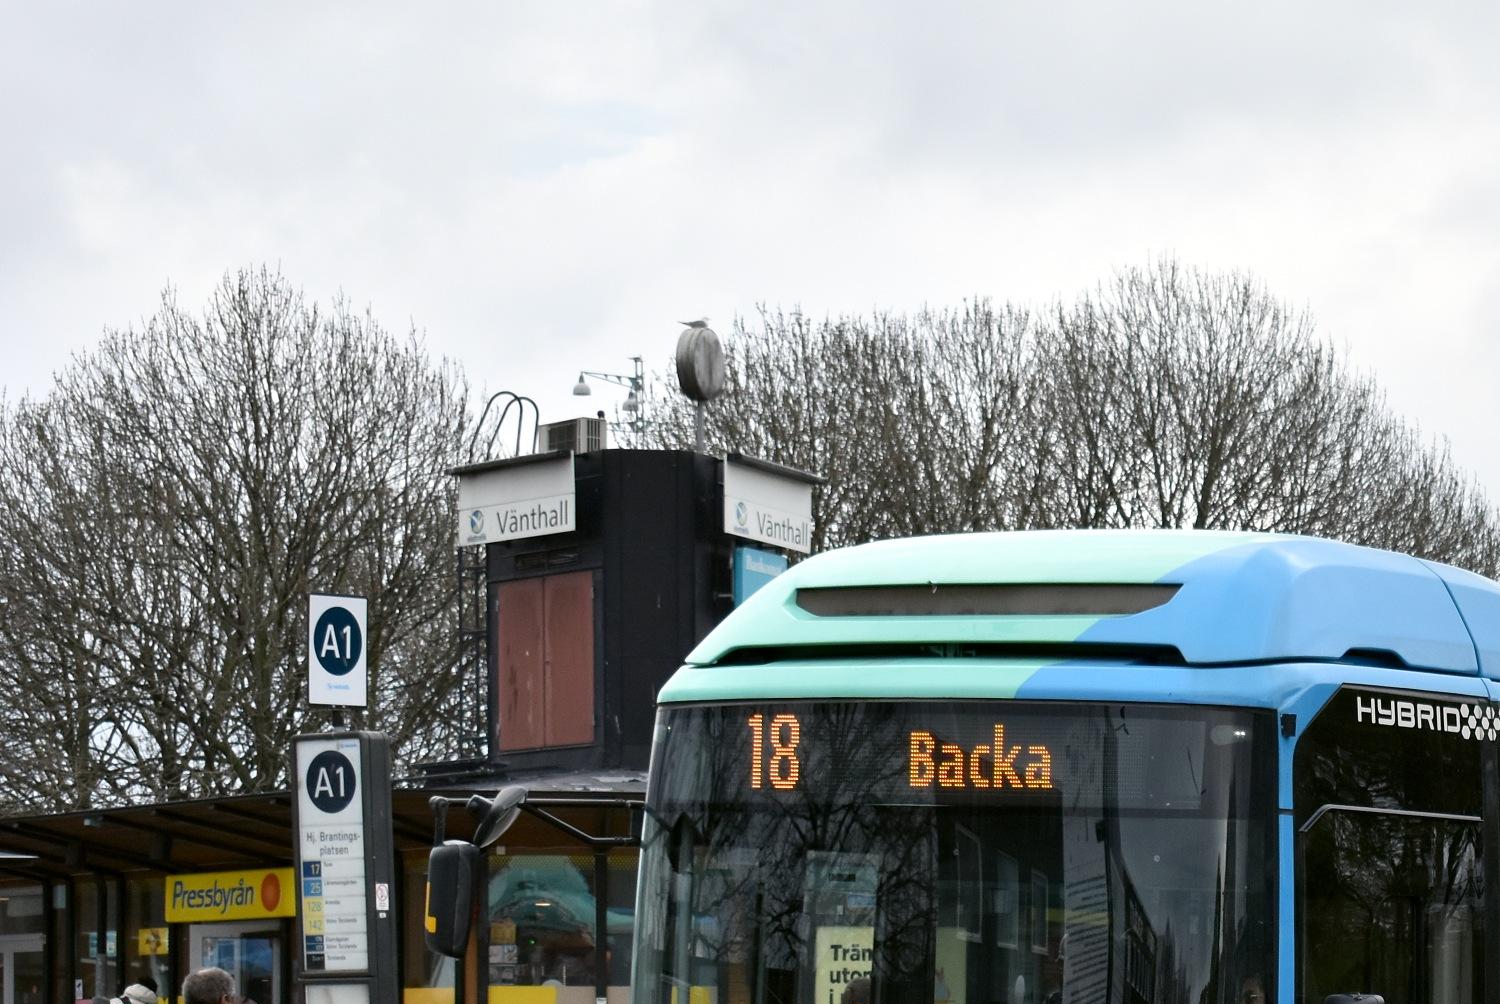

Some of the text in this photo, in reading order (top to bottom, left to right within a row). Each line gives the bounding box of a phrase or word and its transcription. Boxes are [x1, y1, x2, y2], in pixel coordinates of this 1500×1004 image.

[497, 501, 569, 534] Vänthall
[757, 511, 809, 546] Vänthall
[320, 624, 352, 660] A1
[1356, 696, 1461, 733] HYBRID
[749, 714, 1053, 789] 18 Backa
[314, 766, 346, 799] A1
[320, 845, 349, 857] platsen
[311, 864, 321, 876] 17
[172, 878, 254, 914] Pressbyrån
